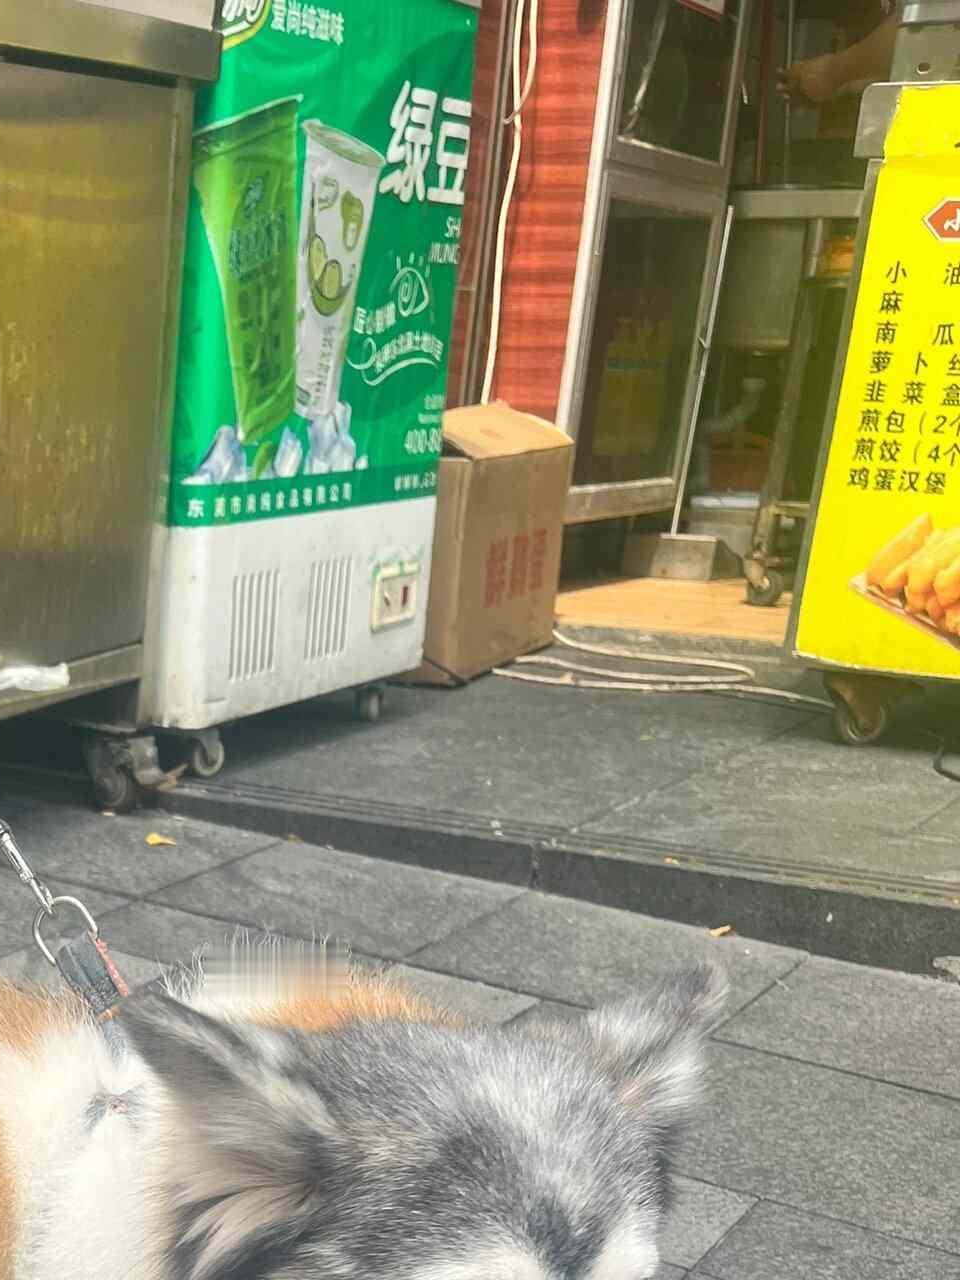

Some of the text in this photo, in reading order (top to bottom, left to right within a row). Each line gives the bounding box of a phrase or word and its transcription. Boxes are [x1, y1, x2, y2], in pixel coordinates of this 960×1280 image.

[379, 80, 472, 205] 绿豆
[879, 289, 904, 314] 麻
[847, 466, 946, 495] 鸡蛋汉堡
